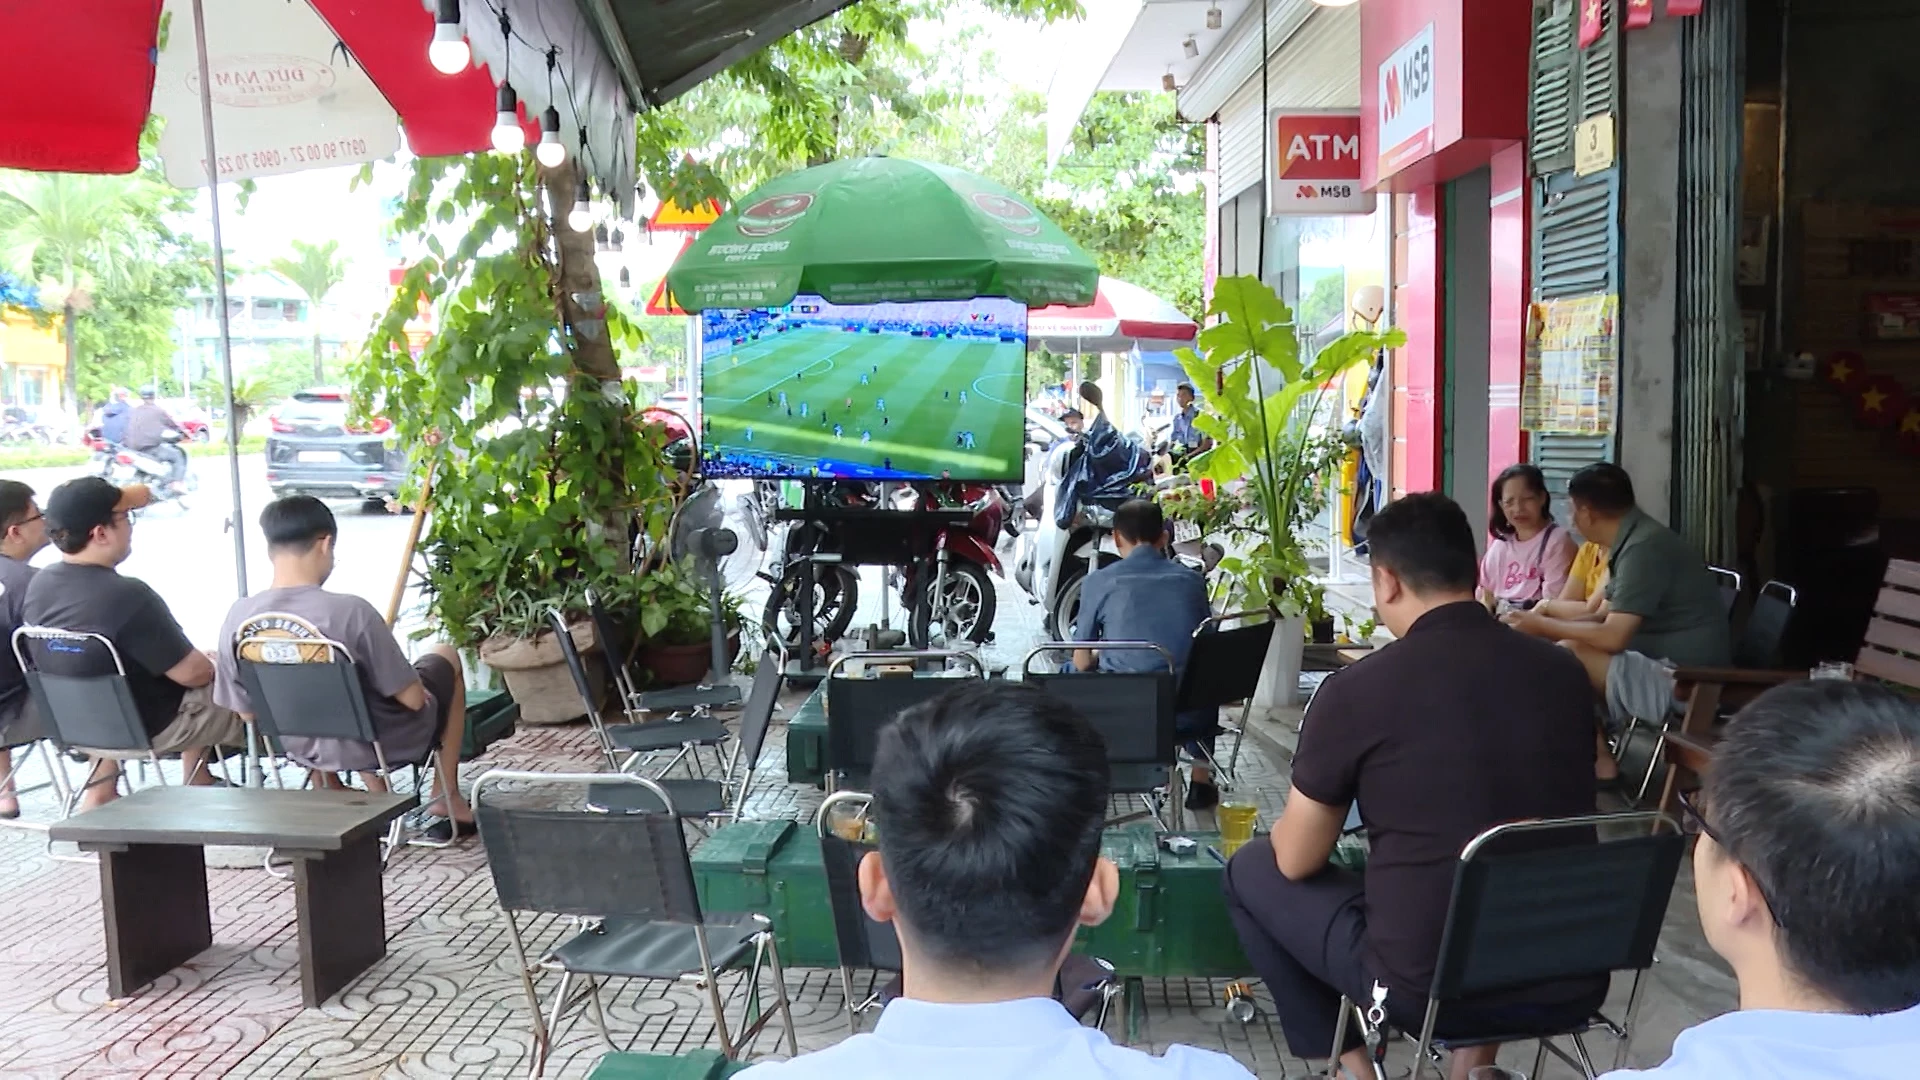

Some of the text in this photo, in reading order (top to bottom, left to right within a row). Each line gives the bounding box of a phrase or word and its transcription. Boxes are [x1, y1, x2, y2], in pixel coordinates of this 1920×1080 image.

[1403, 44, 1430, 106] MSB
[1285, 133, 1360, 161] ATM
[1590, 123, 1598, 151] 3
[1320, 184, 1352, 198] MSB
